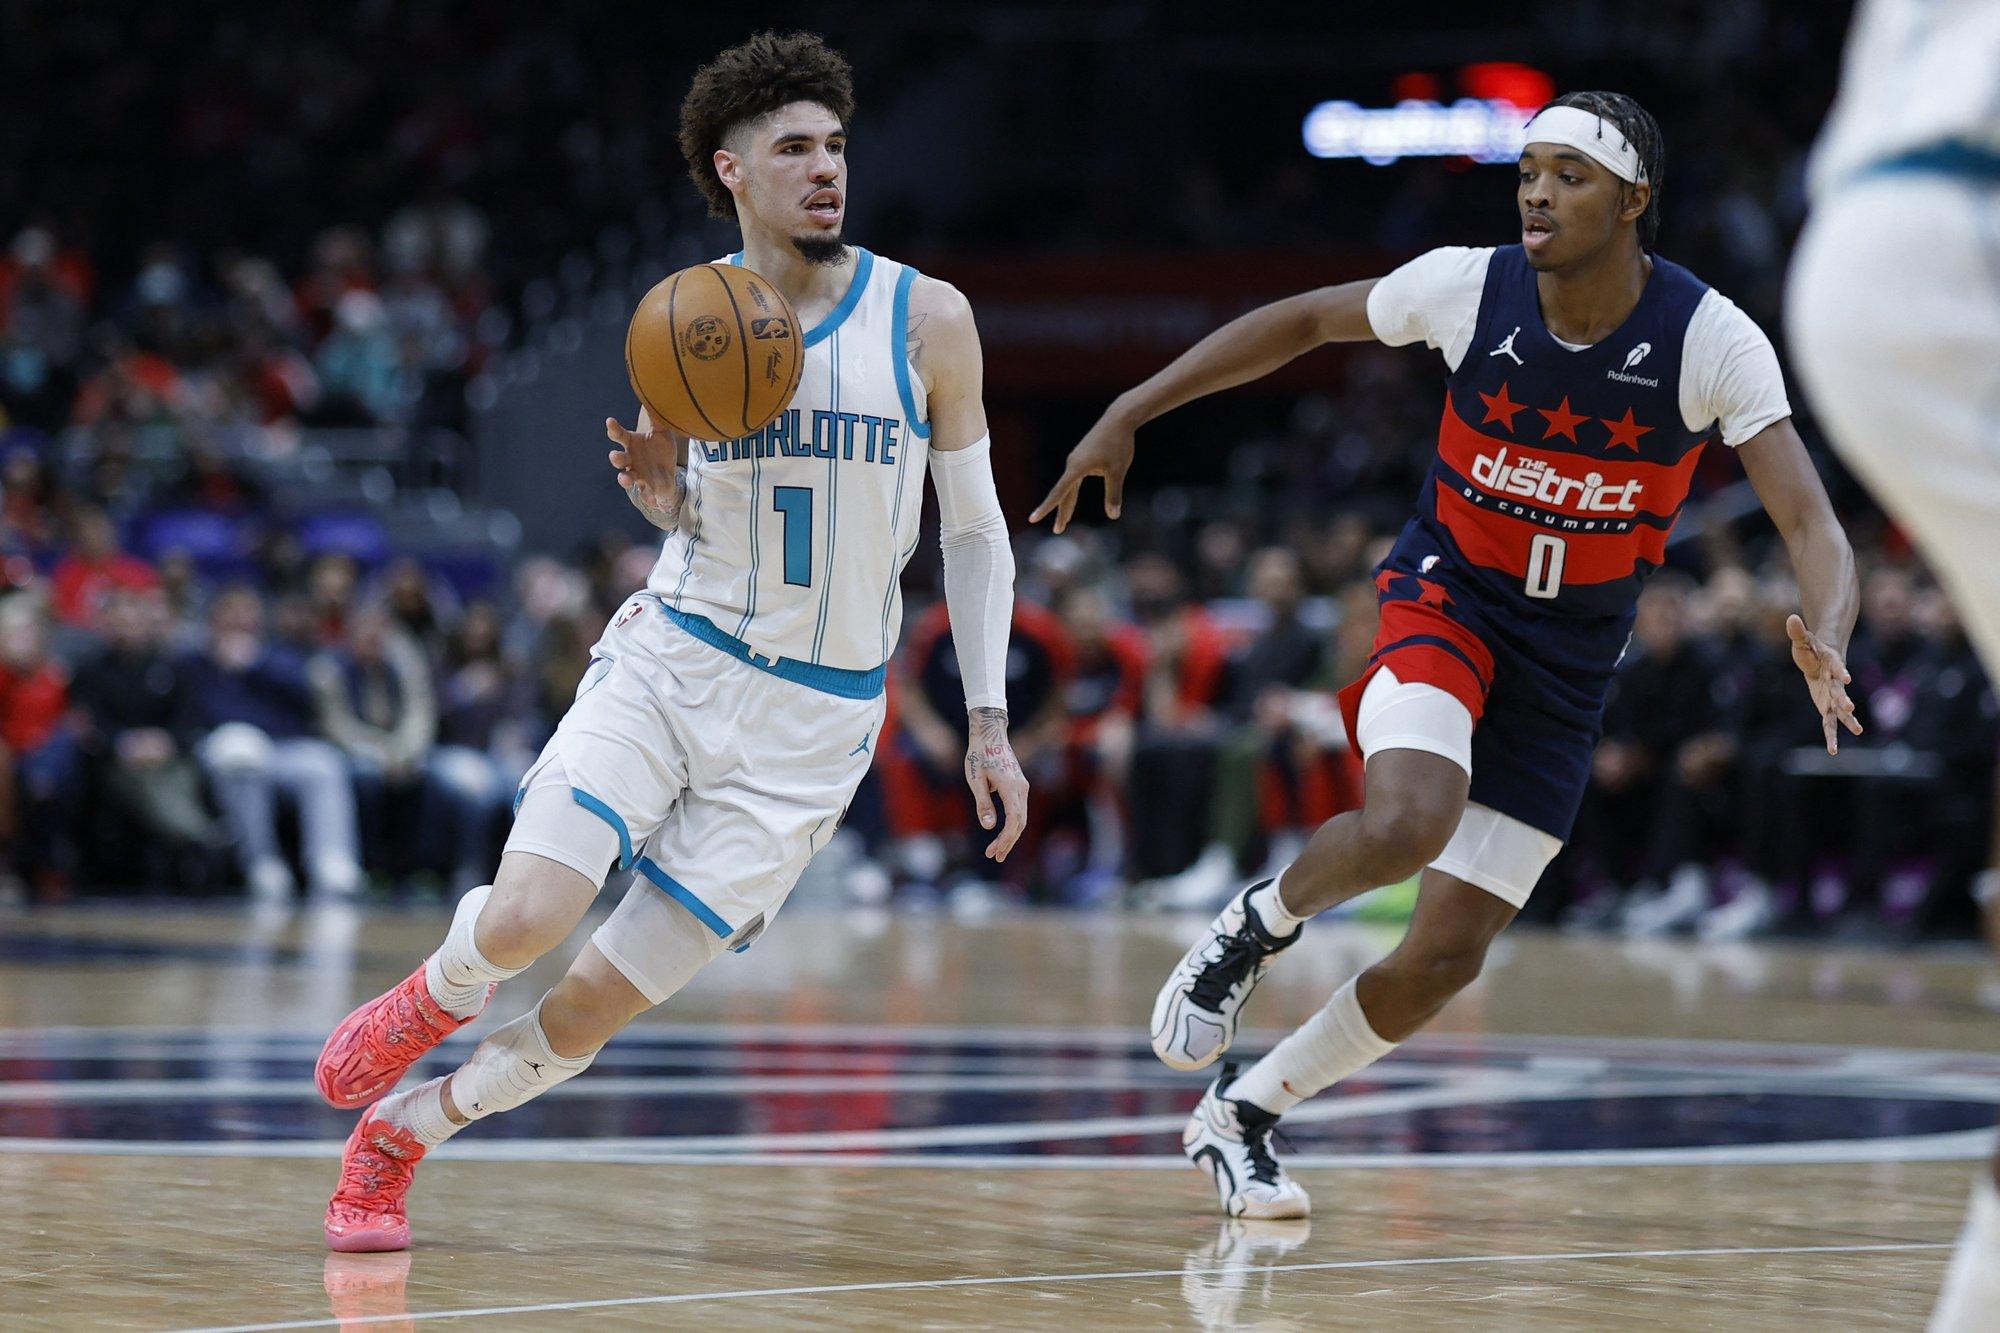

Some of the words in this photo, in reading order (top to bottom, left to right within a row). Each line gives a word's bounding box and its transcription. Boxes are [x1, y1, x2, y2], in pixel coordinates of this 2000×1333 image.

[1607, 370, 1659, 388] Robinhood
[1471, 446, 1644, 512] district
[1517, 456, 1549, 472] THE
[1463, 487, 1483, 503] OF
[1498, 502, 1629, 531] COLUMBIA
[773, 486, 813, 588] 1
[1524, 532, 1567, 600] 0
